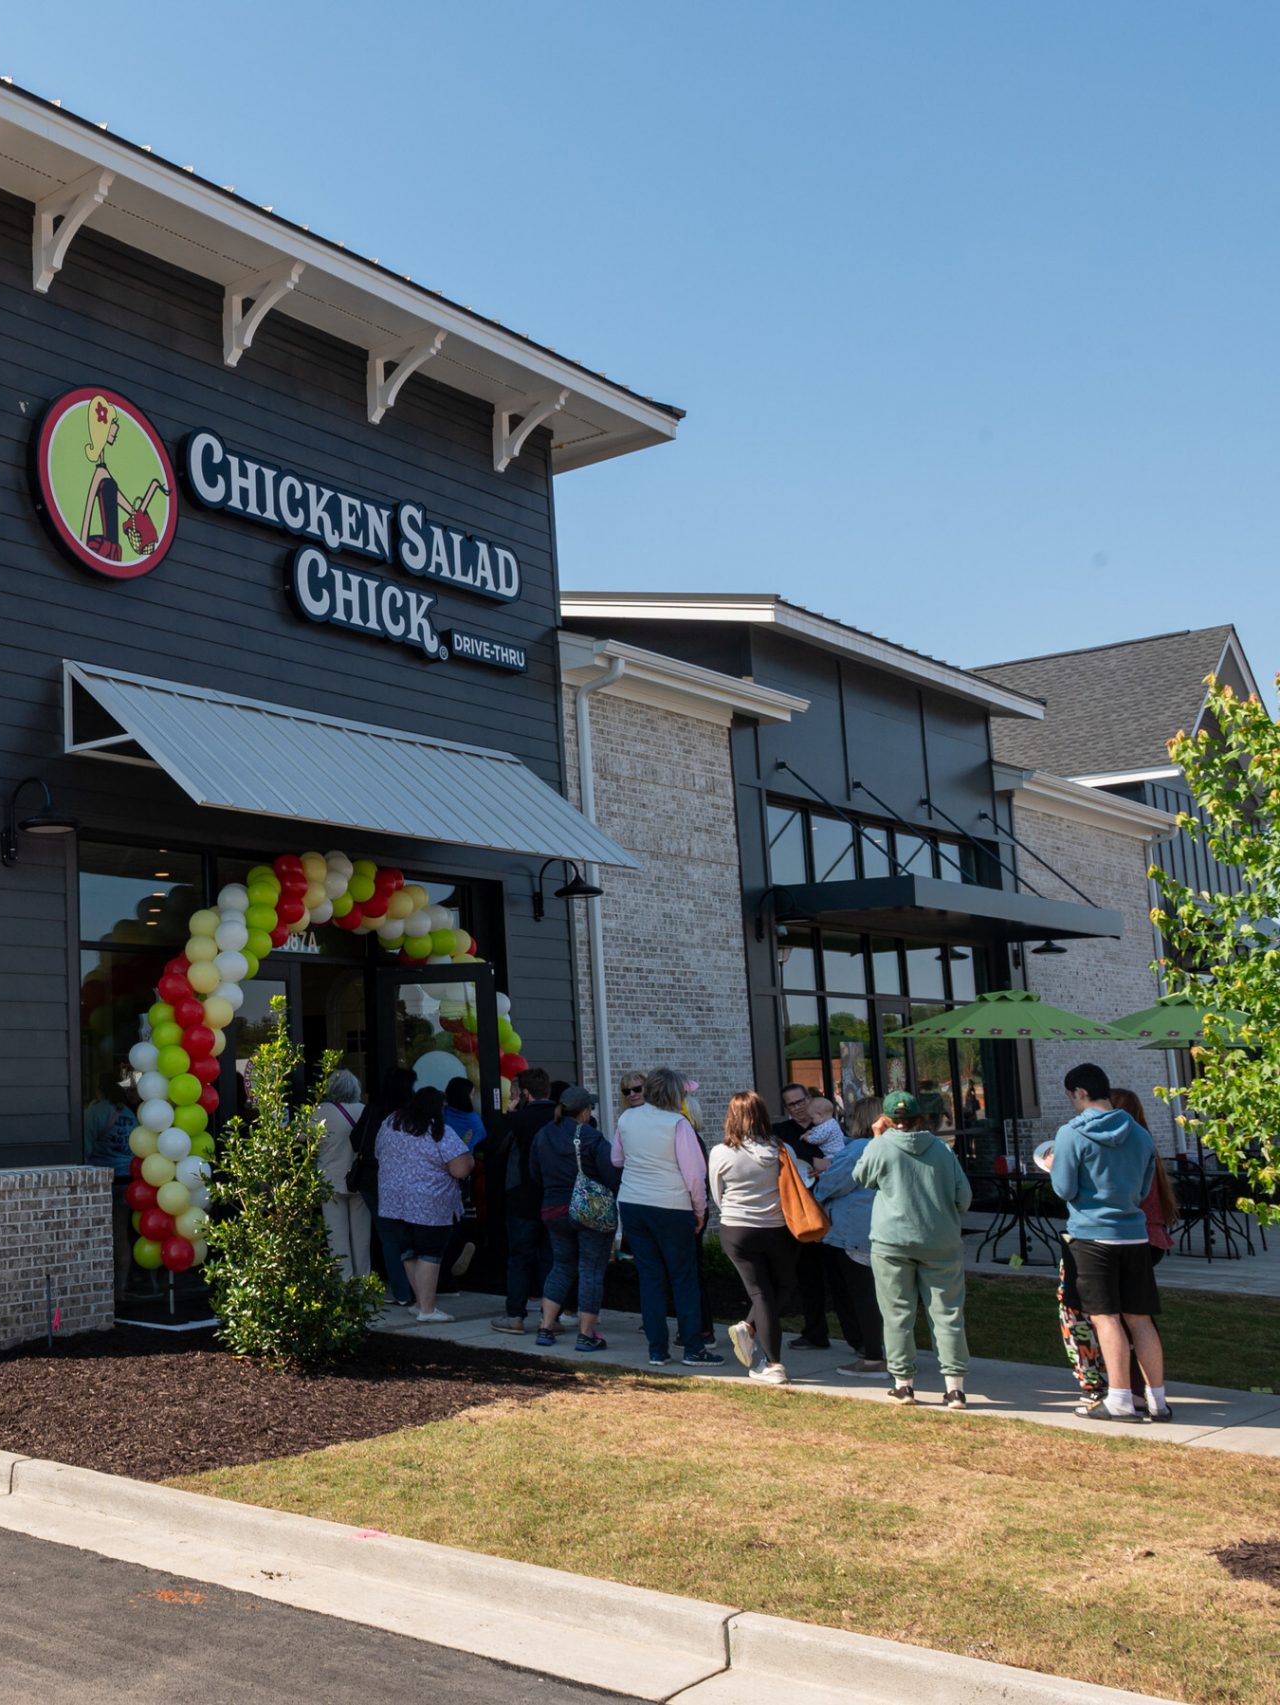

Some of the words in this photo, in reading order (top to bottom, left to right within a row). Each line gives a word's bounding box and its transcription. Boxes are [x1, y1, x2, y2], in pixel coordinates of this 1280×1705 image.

[190, 432, 393, 560] CHICKEN
[398, 503, 519, 598] SALAD
[454, 633, 525, 668] DRIVE-THRU
[278, 931, 318, 953] 87A
